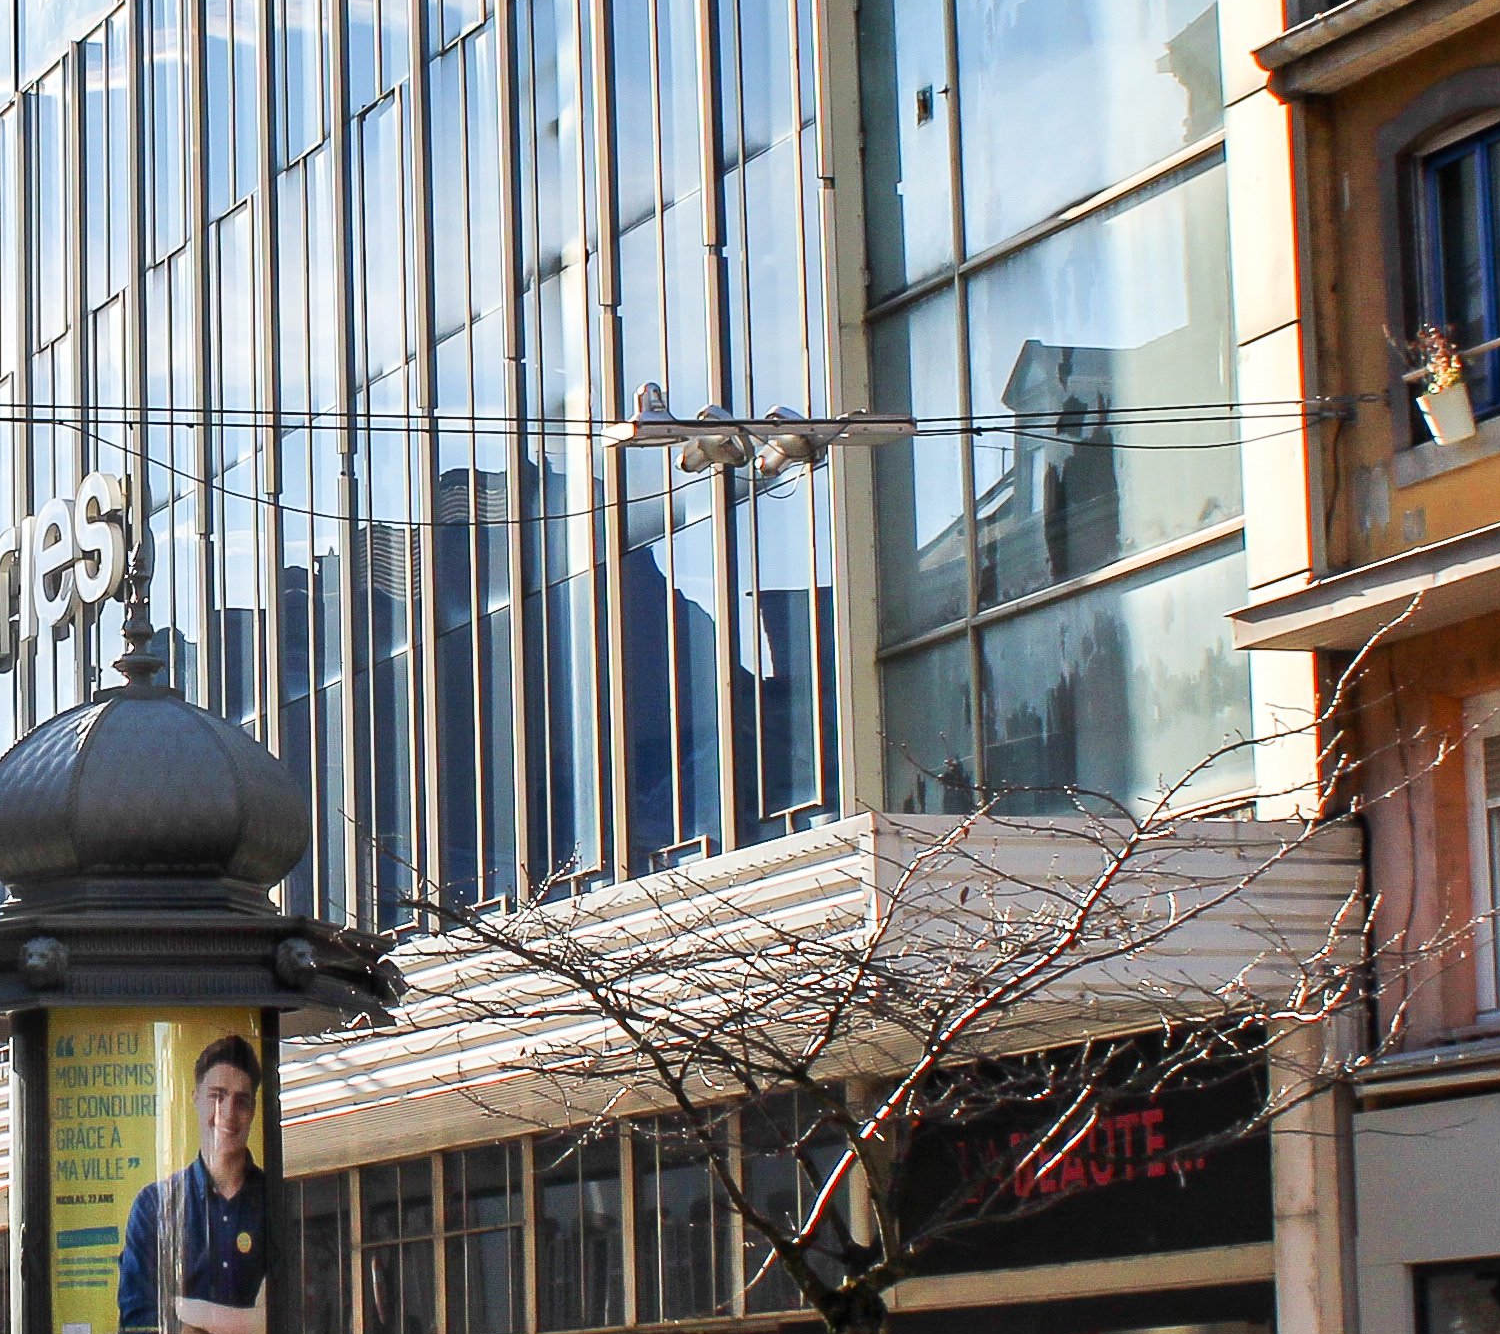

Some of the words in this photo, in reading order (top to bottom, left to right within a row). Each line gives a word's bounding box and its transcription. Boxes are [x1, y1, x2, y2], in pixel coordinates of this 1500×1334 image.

[117, 1032, 139, 1055] EU
[56, 1066, 89, 1088] MON
[93, 1063, 154, 1088] PERMIS
[56, 1097, 74, 1119] DE
[77, 1094, 163, 1117] CONDUIRE
[56, 1158, 79, 1181] MA
[82, 1156, 125, 1181] VILLE
